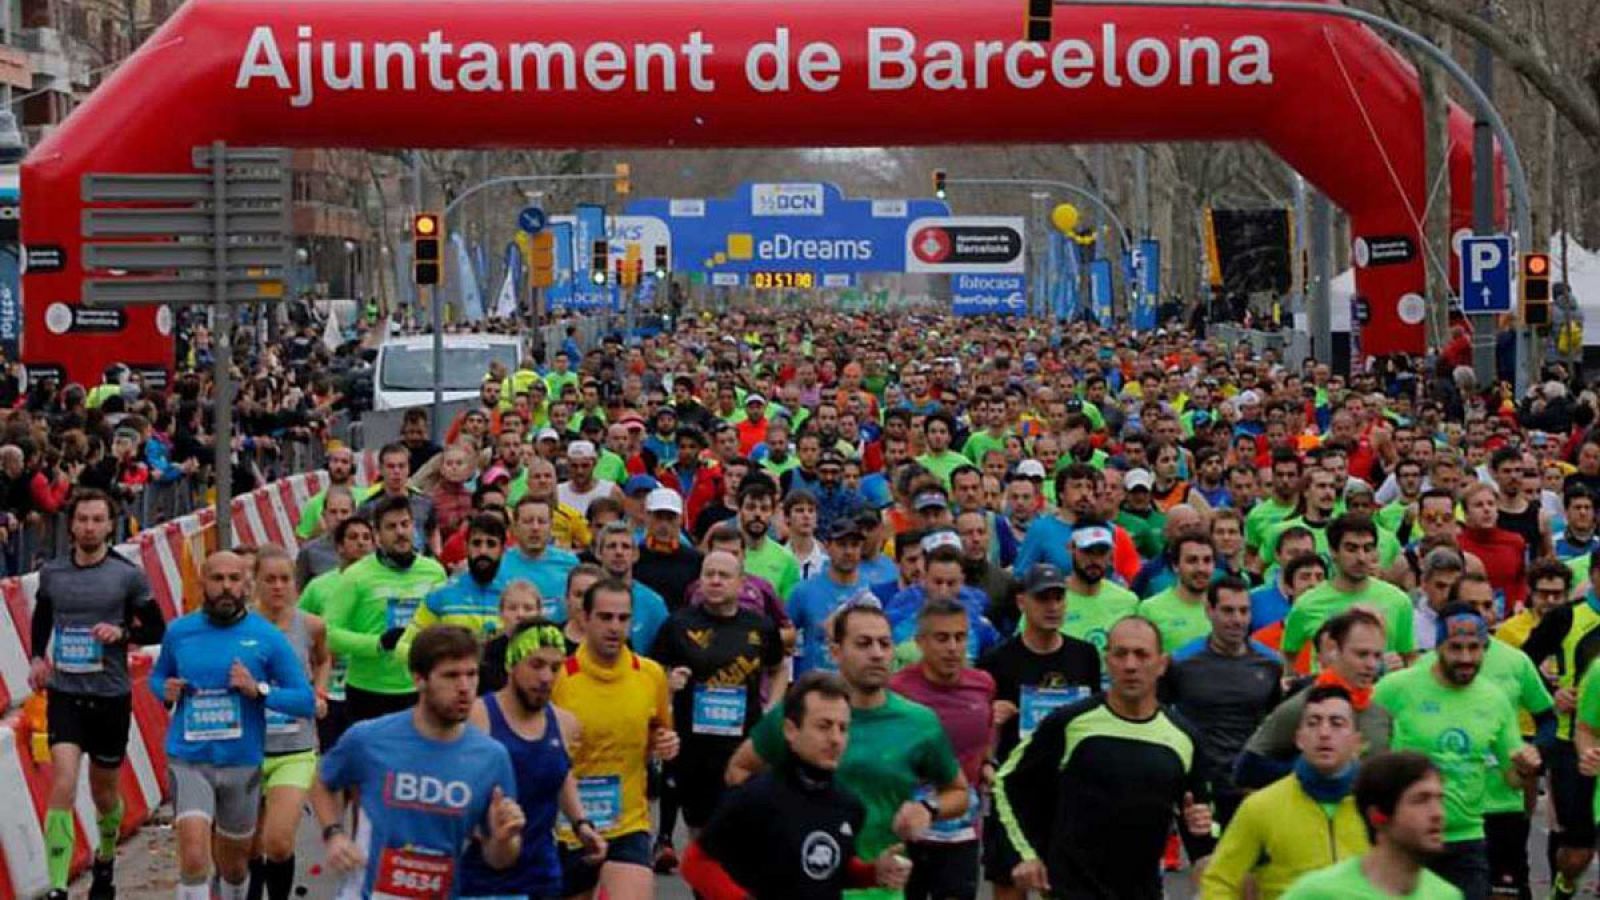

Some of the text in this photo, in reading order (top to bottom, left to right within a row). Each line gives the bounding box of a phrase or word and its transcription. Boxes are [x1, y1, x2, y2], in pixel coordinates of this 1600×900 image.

[235, 23, 1273, 107] Ajuntament de Barcelona
[759, 234, 872, 260] eDreams
[1471, 242, 1502, 283] P
[395, 772, 473, 809] BDO
